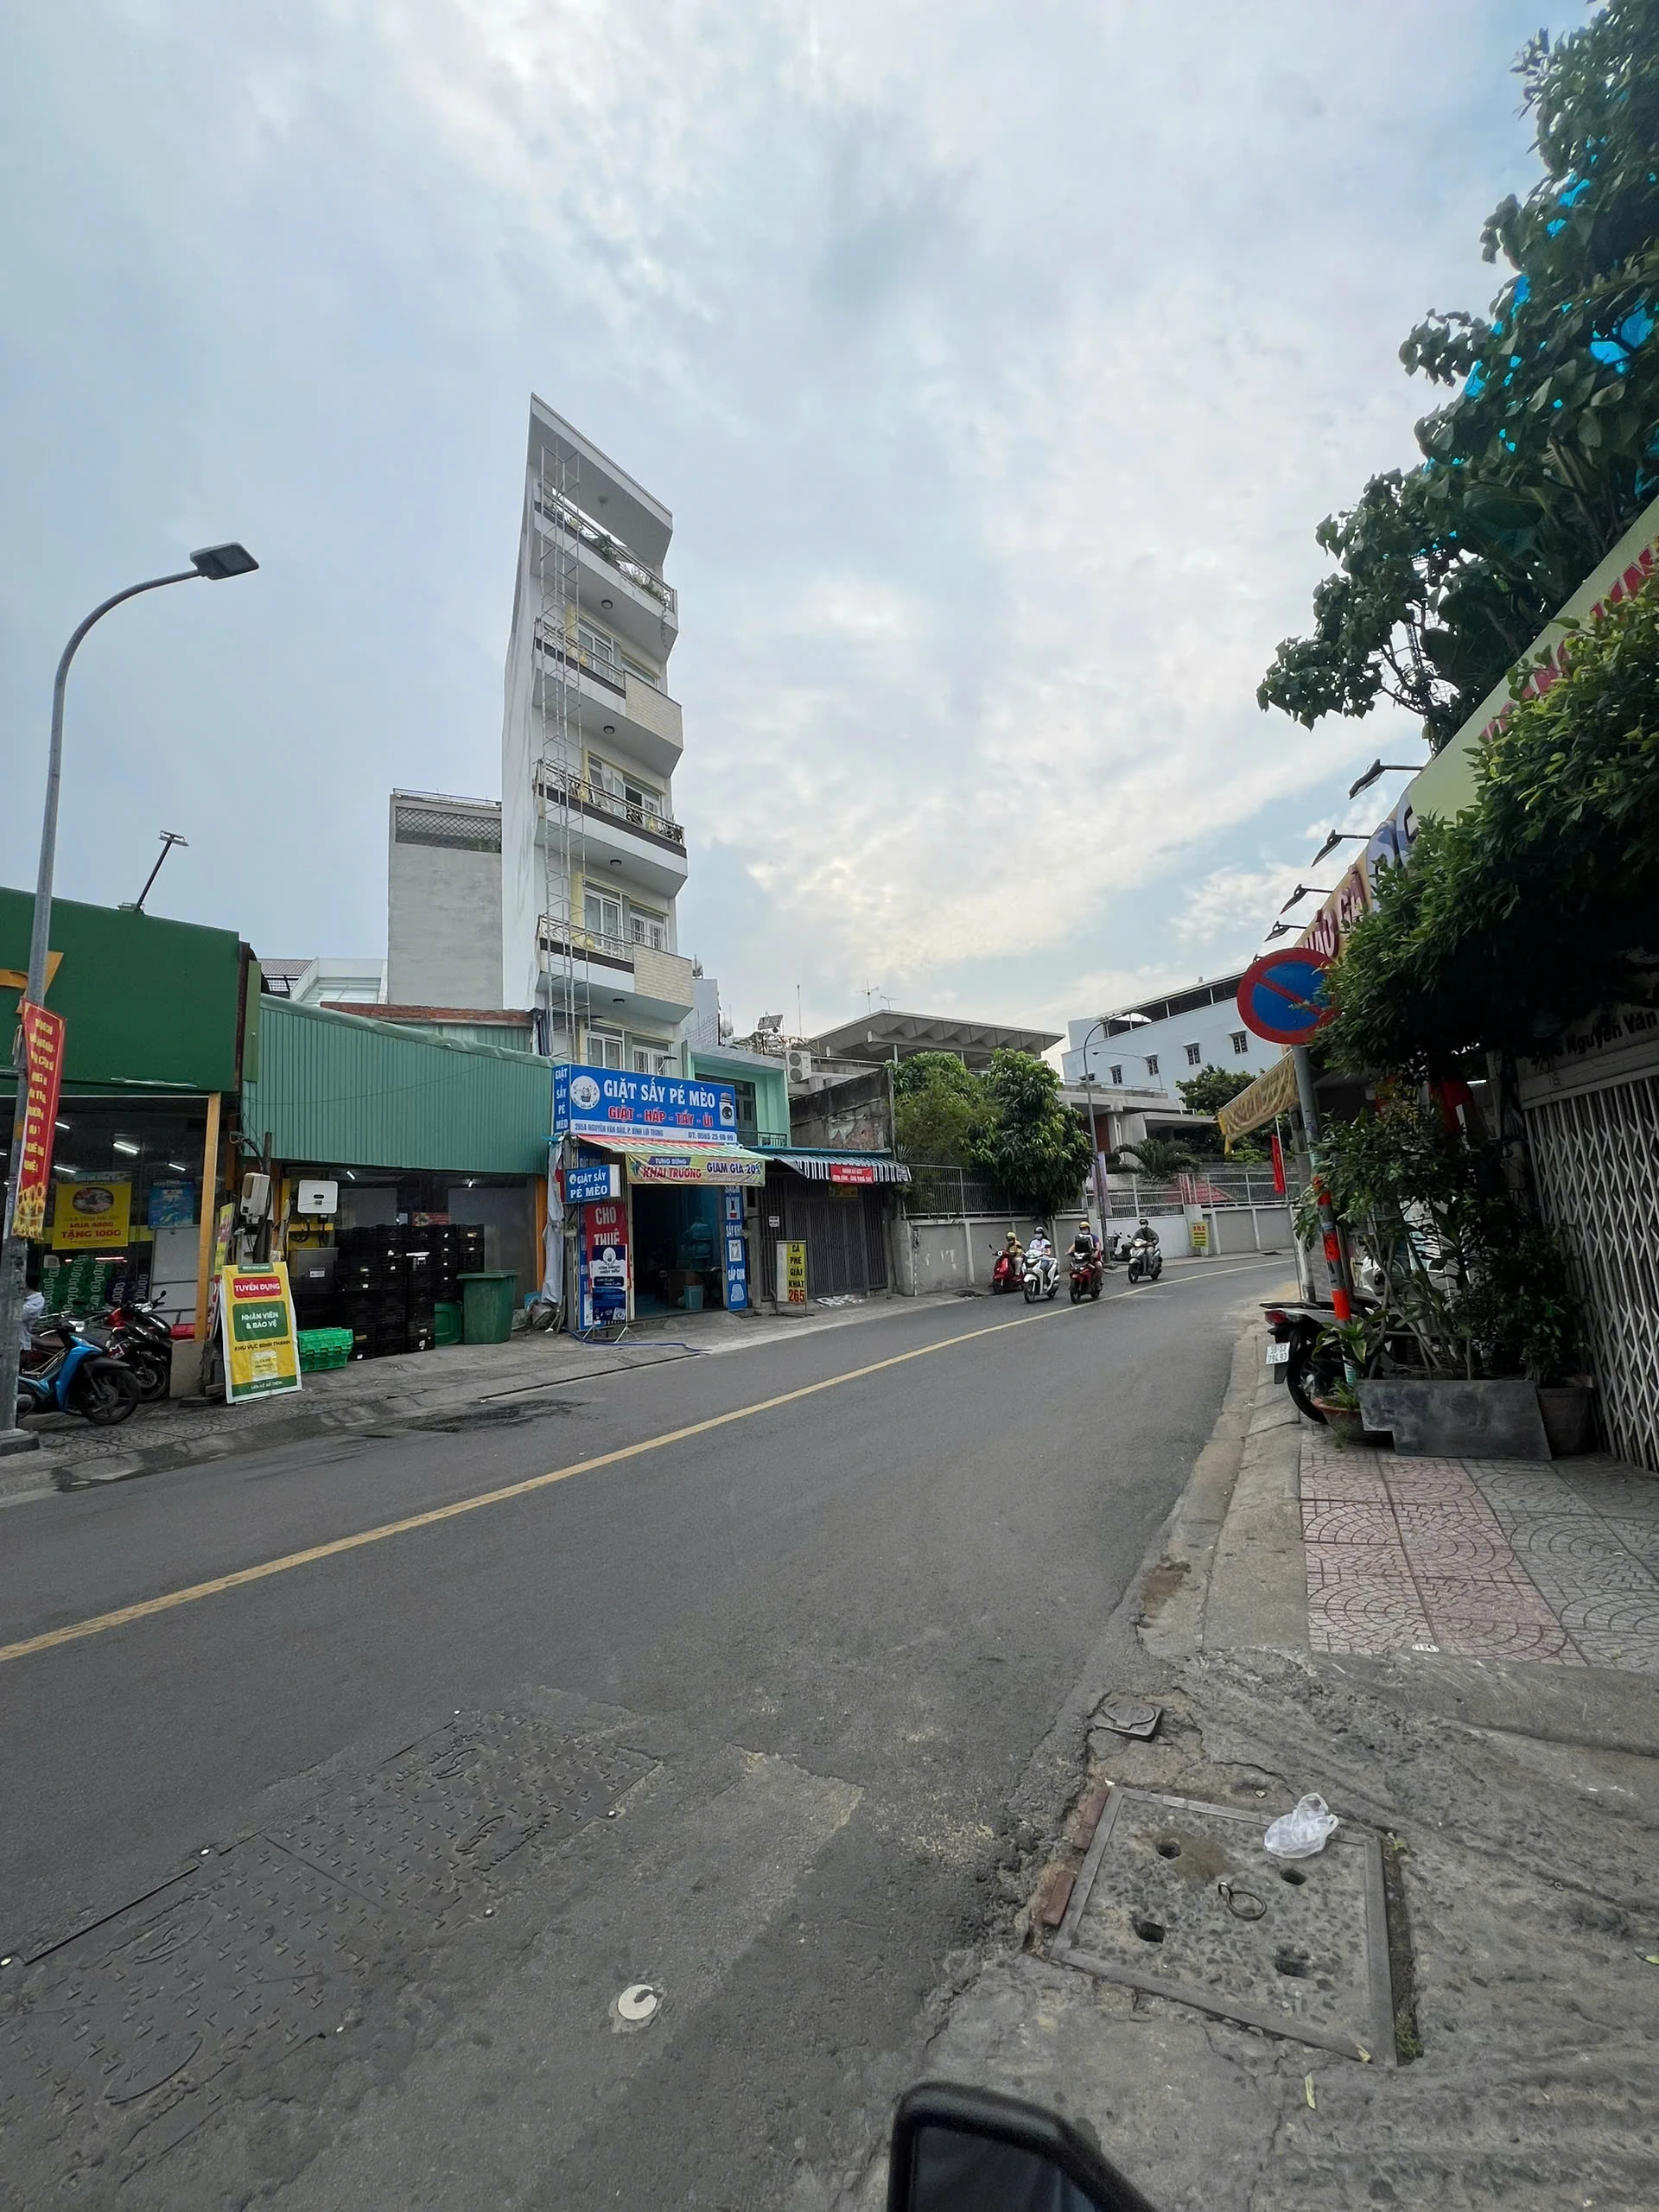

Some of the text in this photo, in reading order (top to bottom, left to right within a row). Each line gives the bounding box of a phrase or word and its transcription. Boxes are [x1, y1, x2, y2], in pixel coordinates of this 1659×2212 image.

[556, 1067, 568, 1081] GIẶT
[556, 1084, 567, 1099] SẤY
[604, 1077, 637, 1104] GIẶT
[641, 1077, 665, 1103] SẤY
[670, 1084, 685, 1105] PÉ
[689, 1086, 715, 1109] MÈO
[558, 1102, 566, 1115] PÉ
[556, 1116, 568, 1129] MÈO
[608, 1107, 635, 1122] GIẶT
[644, 1107, 666, 1123] HẤP
[702, 1111, 713, 1128] ỦI
[577, 1168, 607, 1185] GIẶT SẤY
[643, 1166, 667, 1179] KHAI
[570, 1184, 607, 1199] PÉ MÈO
[594, 1206, 616, 1225] CHO
[260, 1283, 281, 1292] DỤNG
[788, 1289, 804, 1302] 265
[241, 1311, 279, 1321] NHÂN VIÊN
[268, 1319, 277, 1328] VỆ
